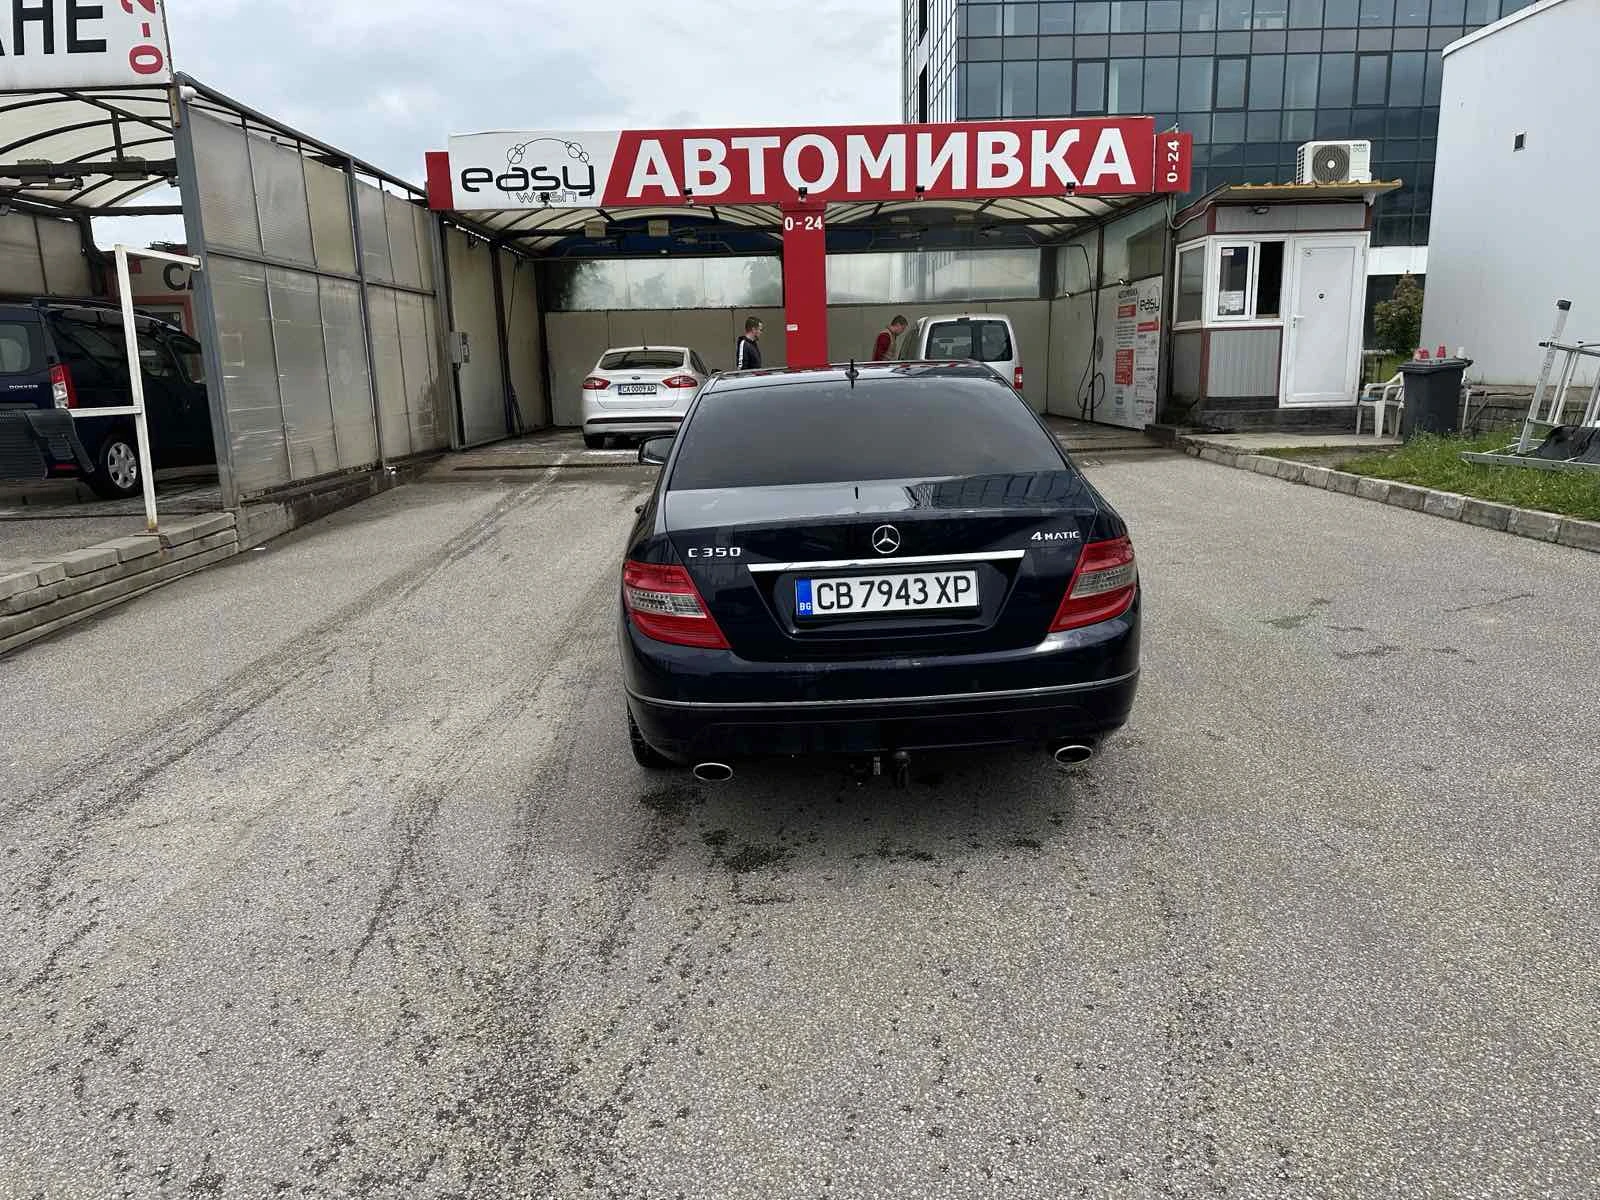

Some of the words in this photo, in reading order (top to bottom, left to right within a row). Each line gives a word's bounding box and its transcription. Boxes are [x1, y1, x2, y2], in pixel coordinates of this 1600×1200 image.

[0, 0, 107, 56] НЕ
[625, 127, 1137, 198] АВТОМИВКА
[461, 165, 596, 197] easy
[688, 548, 698, 558] C
[702, 547, 741, 558] 350
[799, 602, 812, 611] BG
[816, 582, 854, 610] CB
[859, 578, 929, 609] 7943
[935, 575, 971, 604] XP
